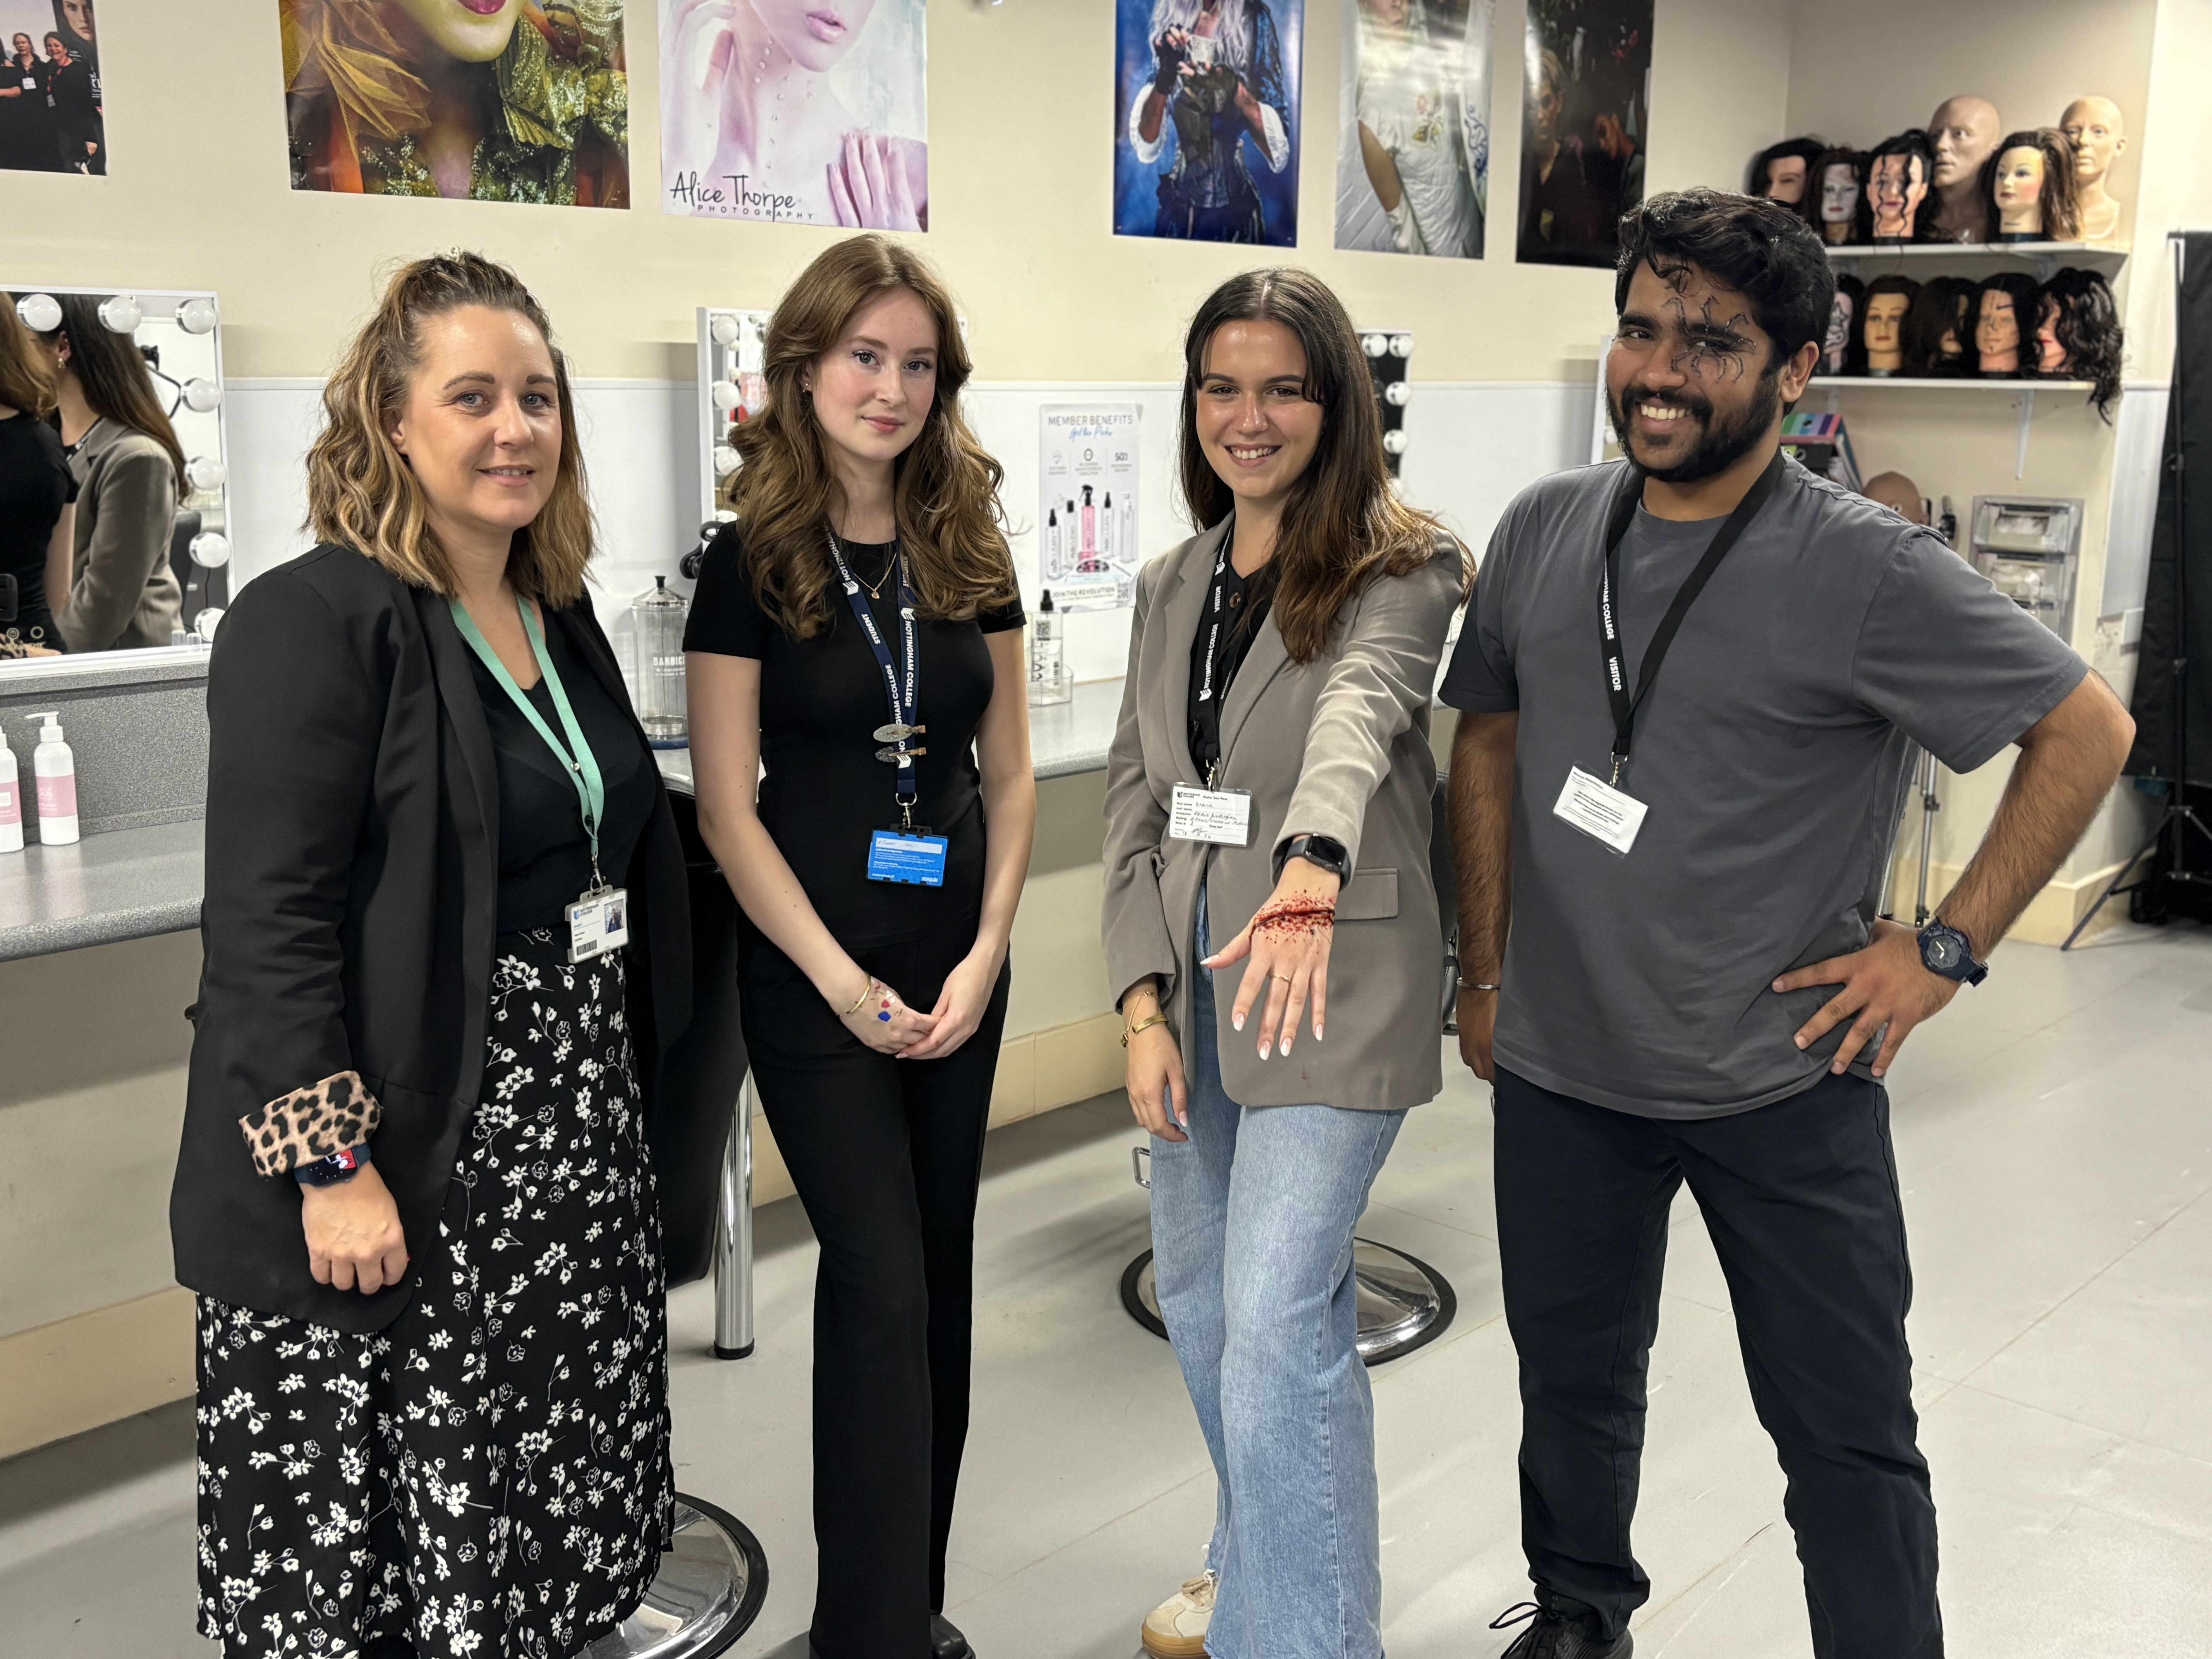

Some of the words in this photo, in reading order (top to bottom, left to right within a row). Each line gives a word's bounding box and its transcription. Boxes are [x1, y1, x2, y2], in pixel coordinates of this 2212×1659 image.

[670, 171, 725, 207] Alice
[722, 174, 796, 222] Thorpe
[698, 205, 813, 219] PHOTOGRAPHY
[1048, 416, 1087, 426] MEMBER
[1090, 415, 1133, 425] BENEFITS
[1069, 427, 1082, 443] Get
[1083, 427, 1092, 436] the
[1079, 587, 1115, 595] REVOLUTION
[861, 613, 881, 645] STUDENT
[1603, 603, 1614, 640] COLLEGE
[905, 620, 914, 670] NOTTINGHAM
[1204, 649, 1214, 689] NOTTINGHAM
[1209, 623, 1219, 649] COLLEGE
[885, 664, 899, 700] COLLEGE
[905, 671, 914, 707] COLLEGE
[1609, 656, 1621, 691] VISITOR
